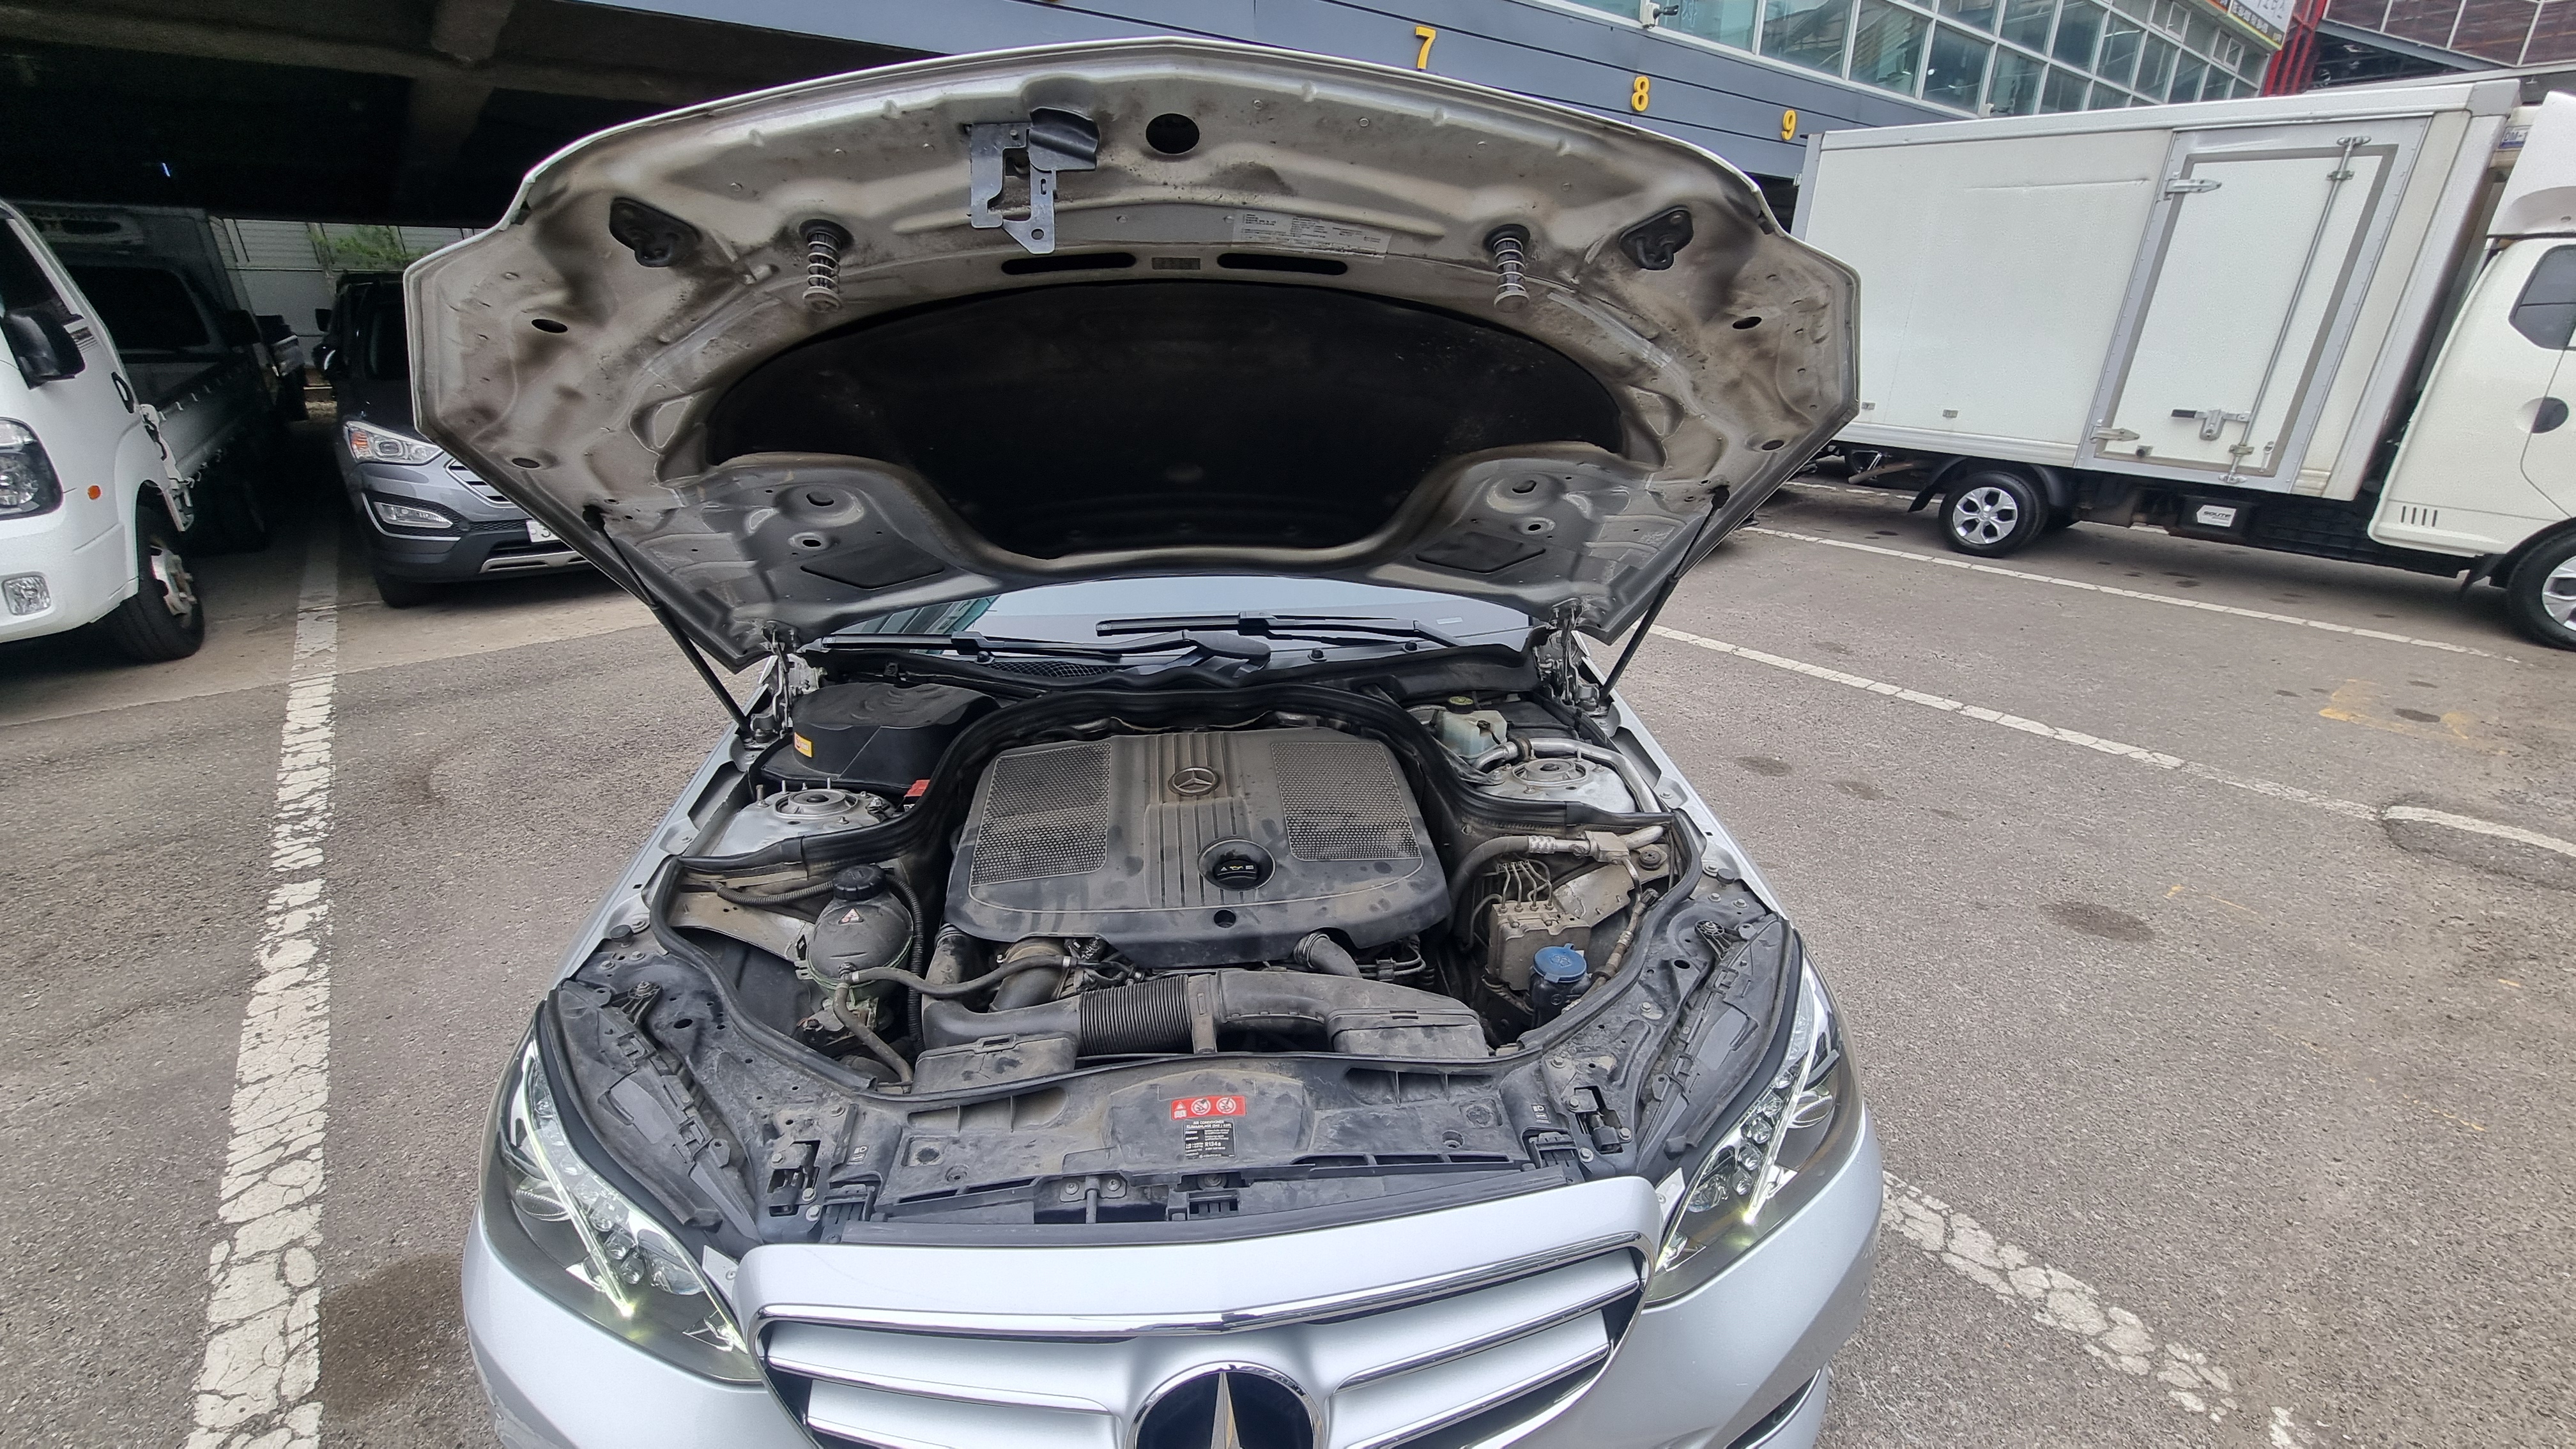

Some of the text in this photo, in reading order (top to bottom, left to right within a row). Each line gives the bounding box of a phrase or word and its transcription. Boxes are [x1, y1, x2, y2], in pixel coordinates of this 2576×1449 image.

[1415, 26, 1437, 70] 7
[1631, 75, 1650, 112] 8
[1781, 109, 1796, 141] 9
